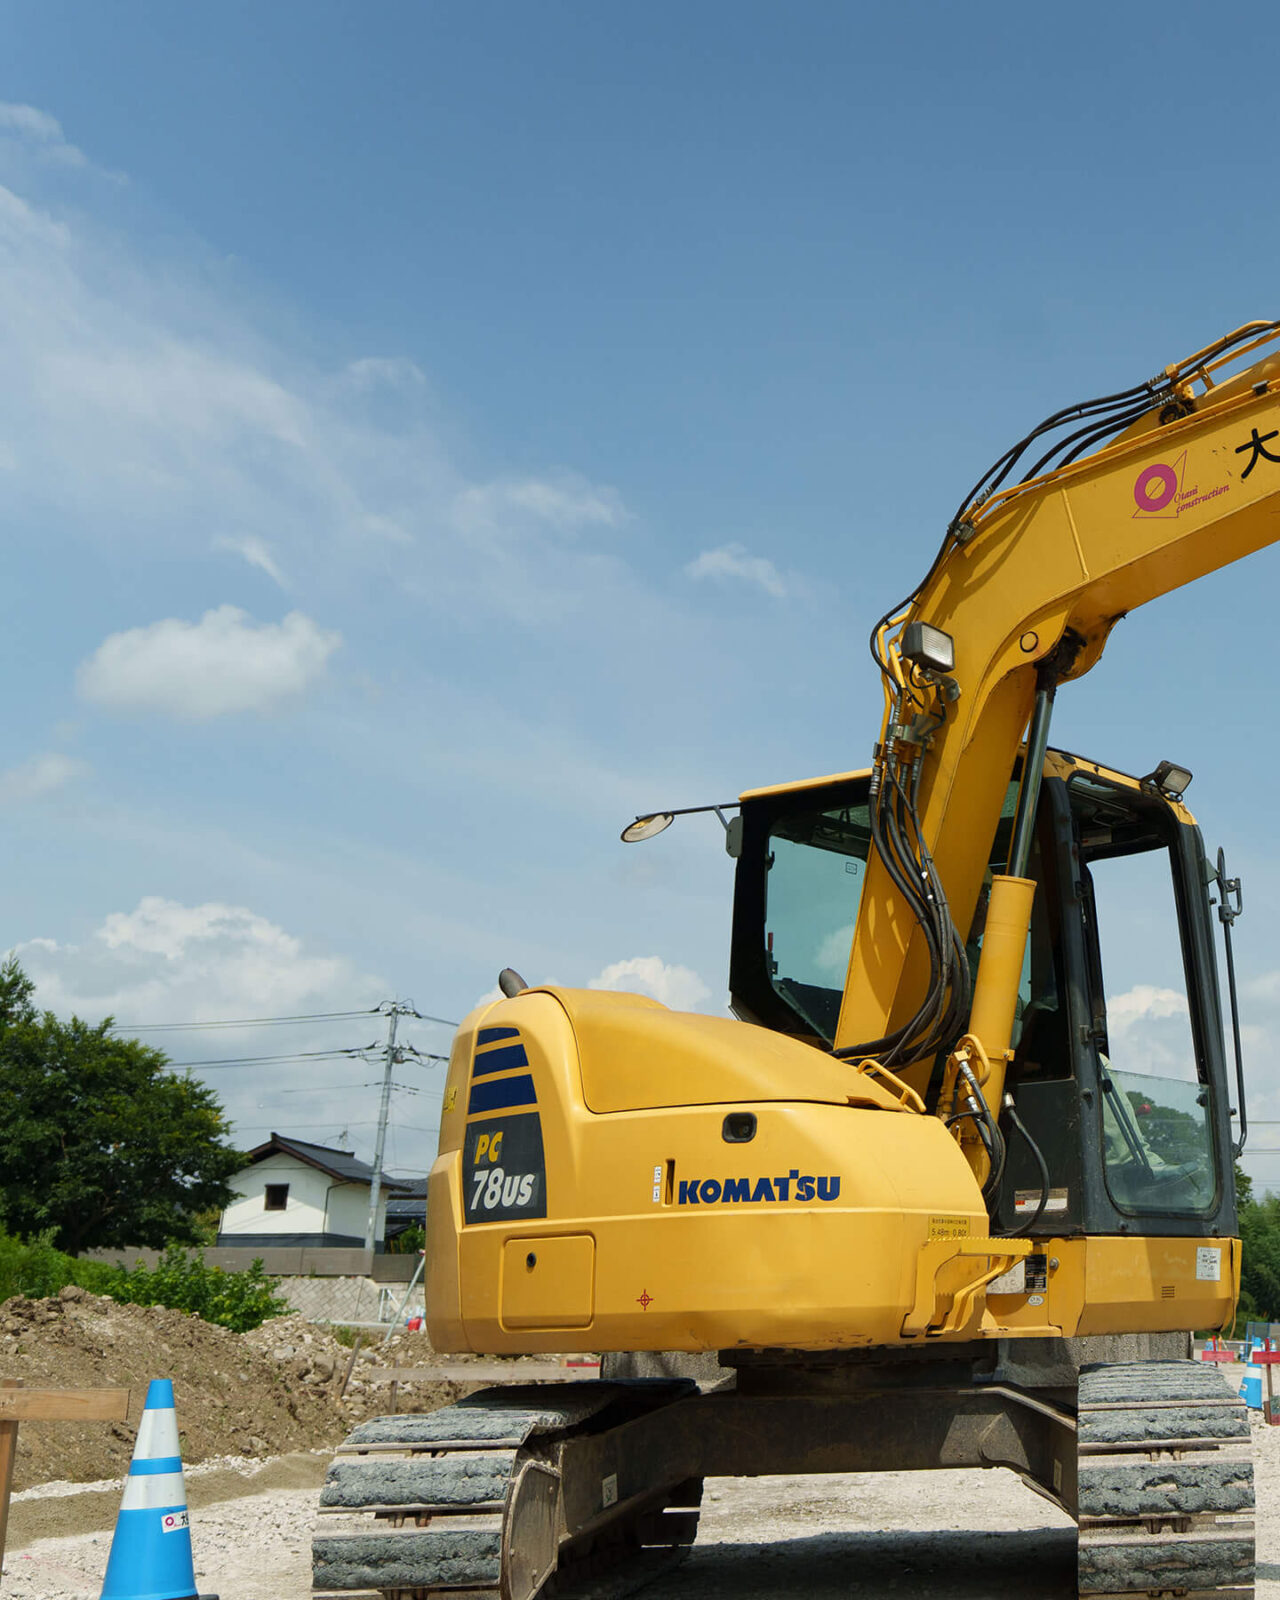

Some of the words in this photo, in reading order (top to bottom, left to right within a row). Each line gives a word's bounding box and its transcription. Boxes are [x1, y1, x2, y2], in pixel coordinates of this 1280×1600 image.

[474, 1131, 504, 1165] PC
[470, 1167, 535, 1210] 78US
[678, 1169, 841, 1205] KOMATSU
